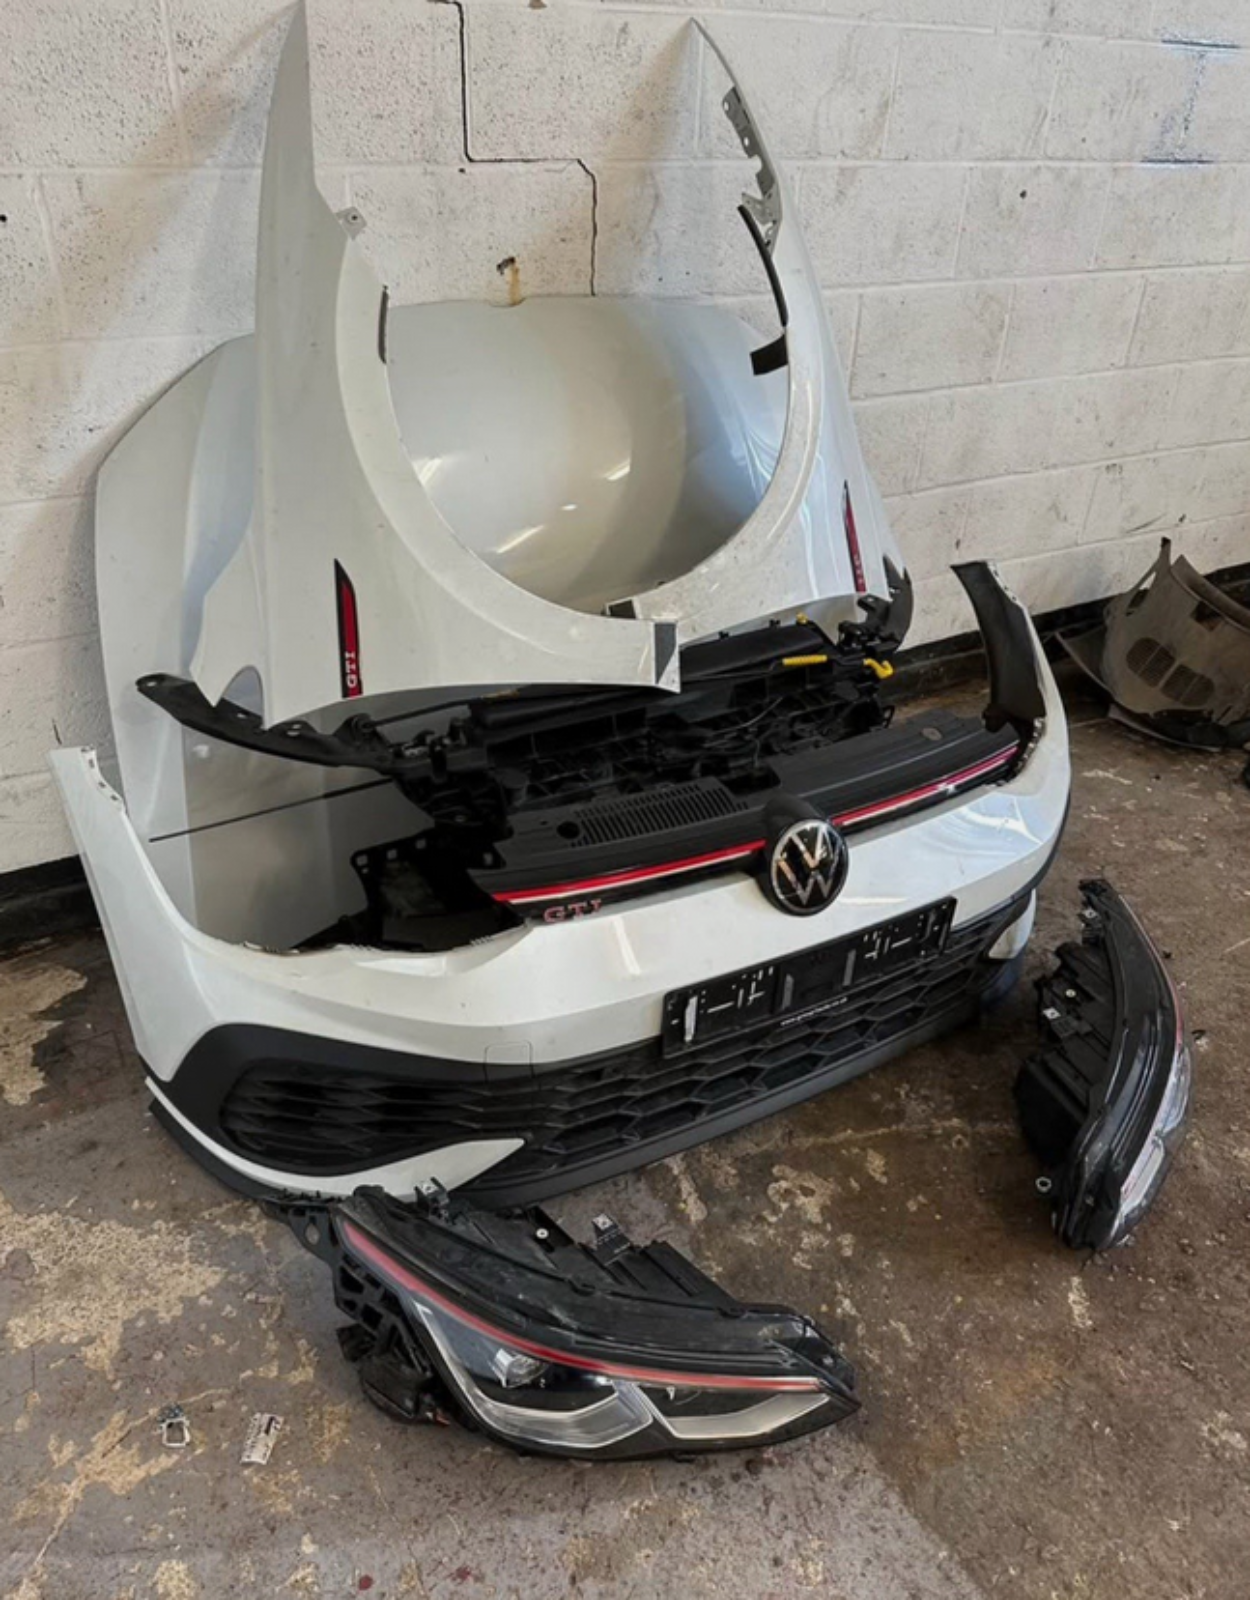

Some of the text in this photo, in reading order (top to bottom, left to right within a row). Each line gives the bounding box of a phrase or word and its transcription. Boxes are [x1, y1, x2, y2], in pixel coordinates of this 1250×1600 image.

[345, 651, 357, 688] GTI
[774, 821, 842, 908] VW
[543, 899, 601, 922] GTI
